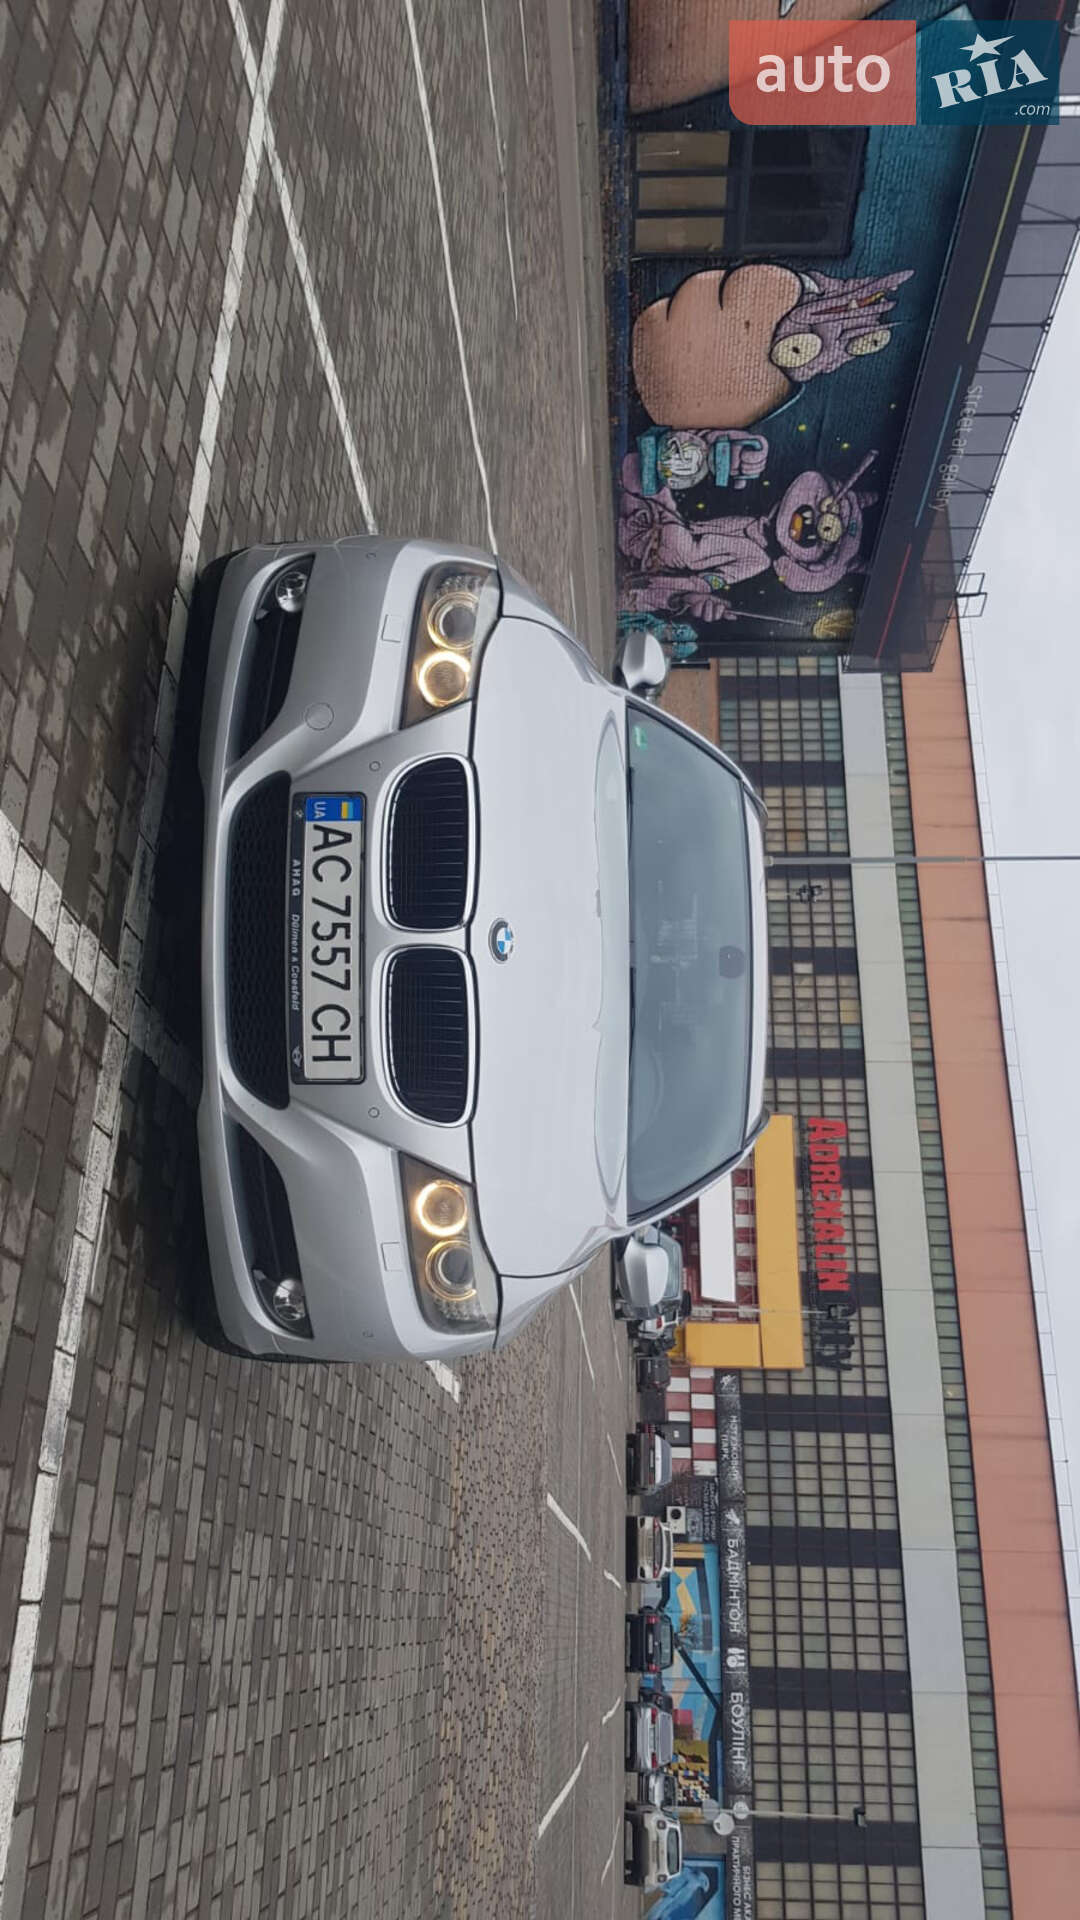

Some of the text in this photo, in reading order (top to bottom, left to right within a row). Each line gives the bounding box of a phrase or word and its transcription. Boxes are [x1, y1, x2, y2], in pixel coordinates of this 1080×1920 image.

[928, 384, 983, 512] street art gallery
[312, 801, 326, 819] UA
[311, 824, 352, 1063] AC 7557 CH
[807, 1117, 850, 1292] ADRENALIN
[726, 1538, 741, 1634] БАДМІНТОН
[729, 1691, 746, 1771] БОУЛІНГ
